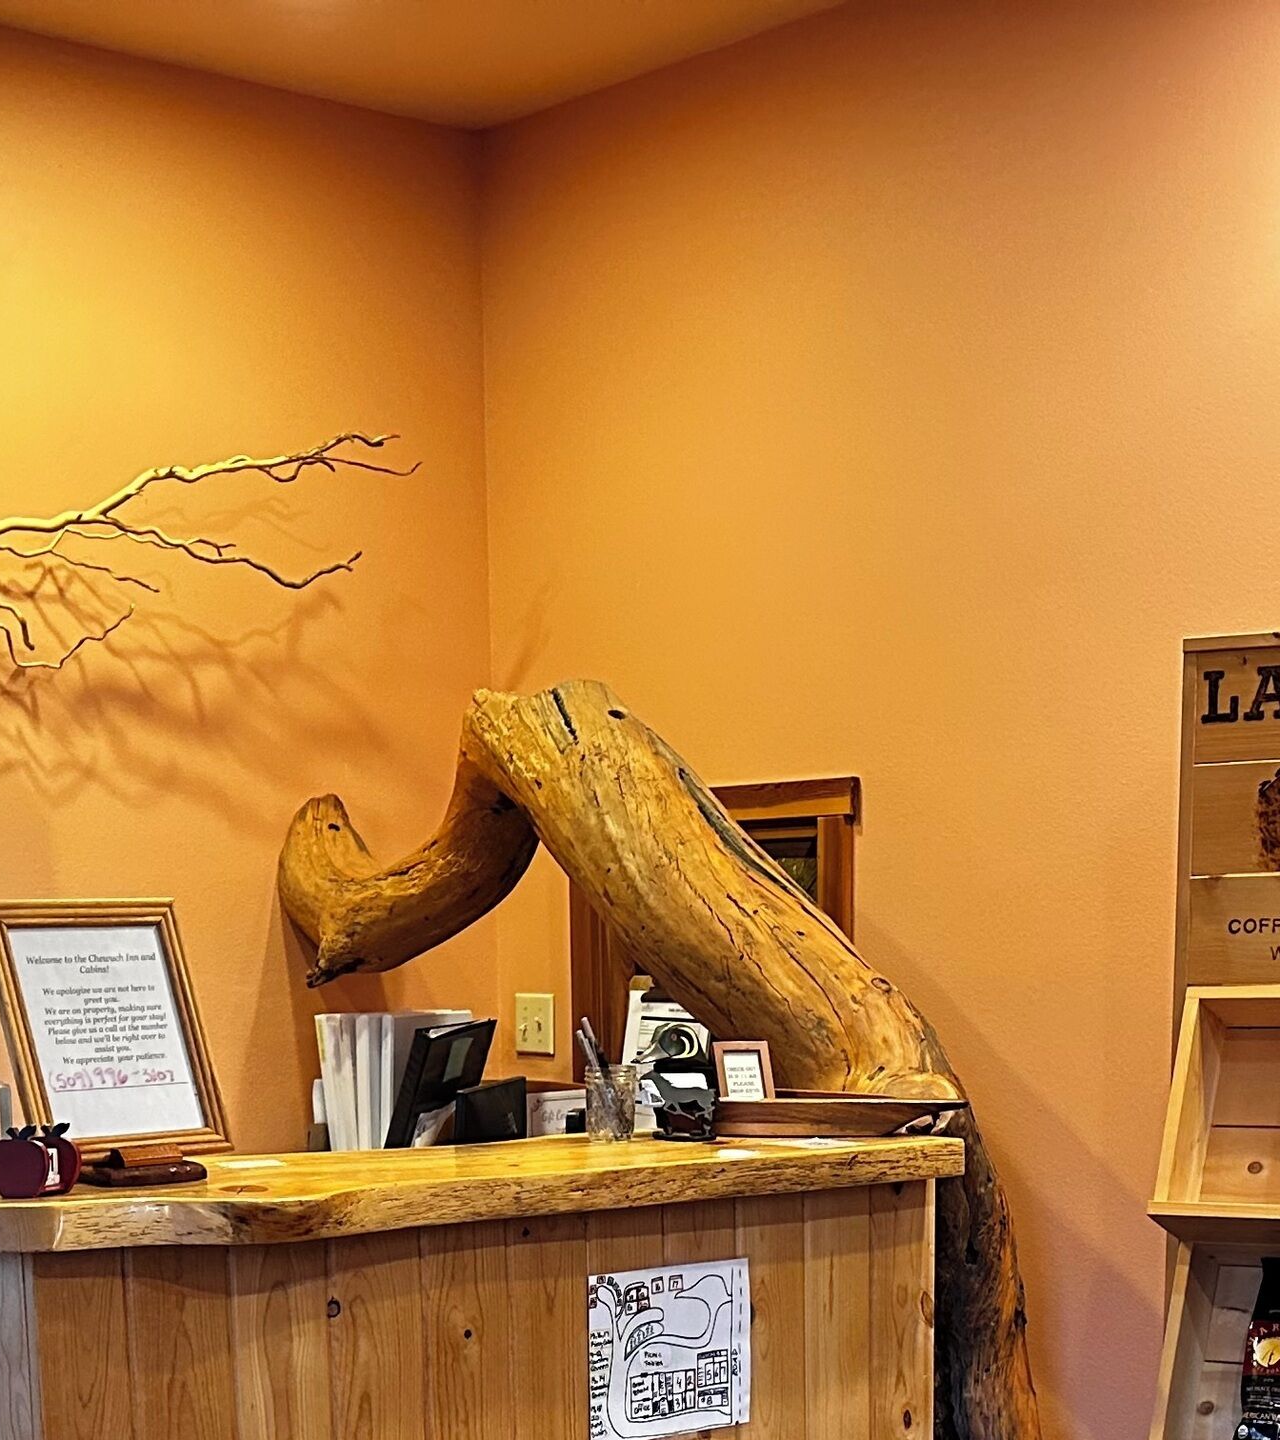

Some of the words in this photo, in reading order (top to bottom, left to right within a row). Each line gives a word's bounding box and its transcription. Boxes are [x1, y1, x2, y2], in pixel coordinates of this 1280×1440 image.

[26, 956, 62, 965] Welcome
[64, 956, 73, 964] to
[74, 954, 87, 964] the
[125, 954, 140, 962] Inn
[140, 952, 156, 962] and
[42, 987, 55, 996] We
[44, 1007, 56, 1016] We
[118, 1004, 146, 1013] making
[44, 1017, 84, 1026] everything
[92, 1015, 118, 1025] perfect
[118, 1014, 128, 1024] for
[47, 1026, 70, 1036] Please
[71, 1026, 87, 1035] give
[104, 1024, 118, 1032] call
[128, 1024, 140, 1032] the
[140, 1022, 168, 1030] number
[77, 1036, 92, 1044] and
[112, 1034, 120, 1042] be
[121, 1033, 140, 1042] right
[157, 1032, 166, 1040] to
[62, 1056, 74, 1064] We
[76, 1055, 114, 1066] appreciate
[117, 1054, 134, 1062] your
[706, 1369, 712, 1380] 5
[720, 1366, 726, 1375] 7
[676, 1376, 682, 1390] 4
[686, 1375, 694, 1386] 2
[674, 1397, 681, 1409] 3
